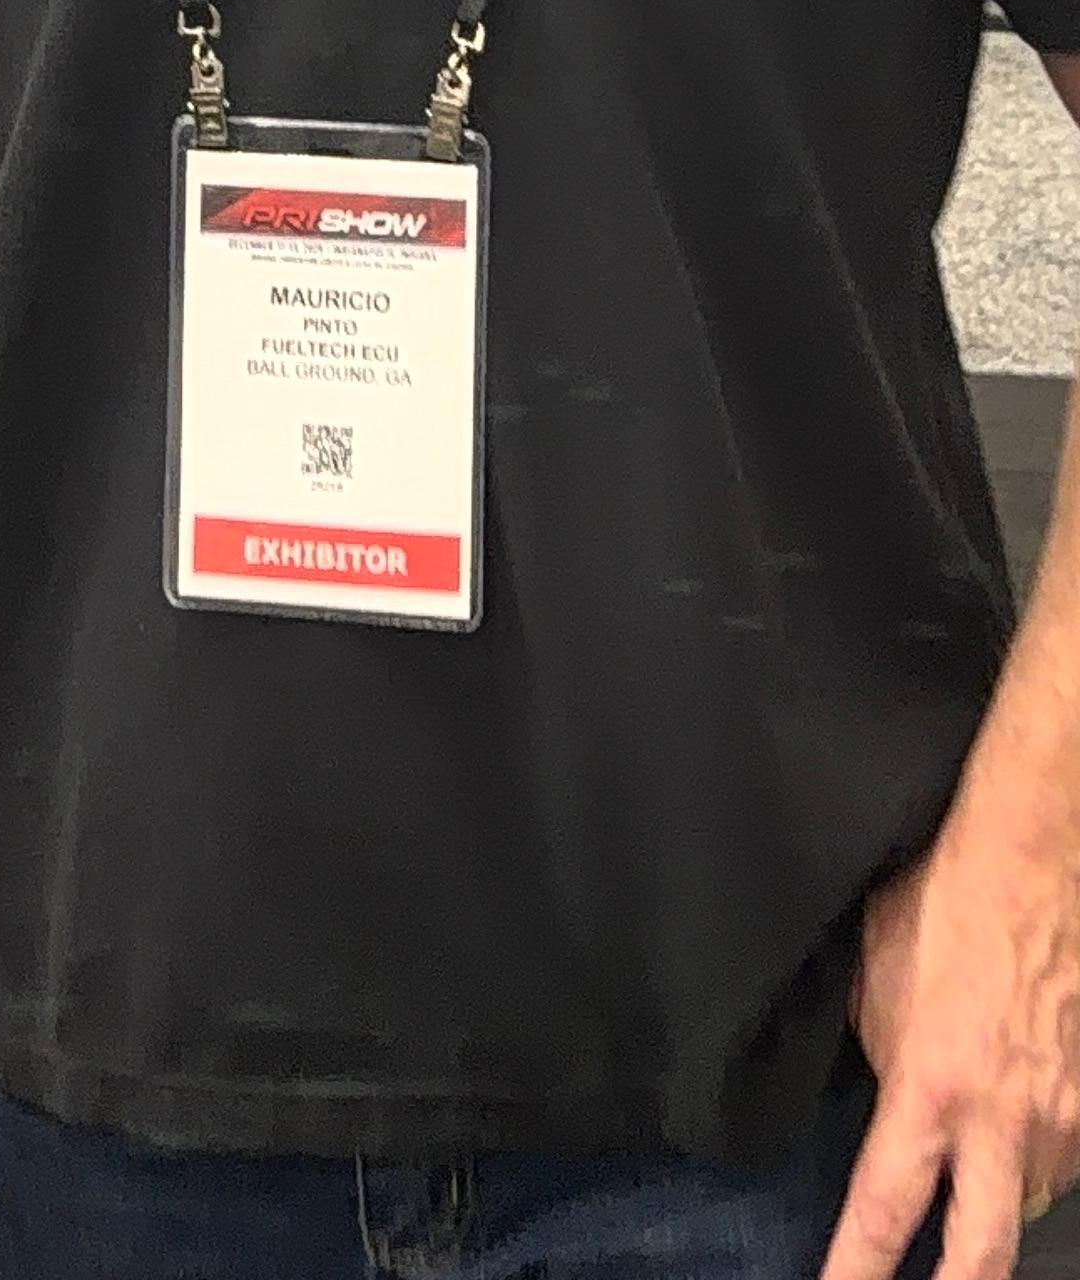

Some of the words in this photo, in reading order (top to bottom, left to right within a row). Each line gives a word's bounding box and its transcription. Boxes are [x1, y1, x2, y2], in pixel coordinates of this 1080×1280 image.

[270, 286, 391, 313] MAURICIO
[303, 317, 358, 336] PINTO
[261, 338, 356, 360] FUELTECH
[362, 345, 399, 363] ECU
[247, 359, 290, 378] BALL
[386, 368, 412, 387] GA
[244, 535, 408, 576] EXHIBITOR
